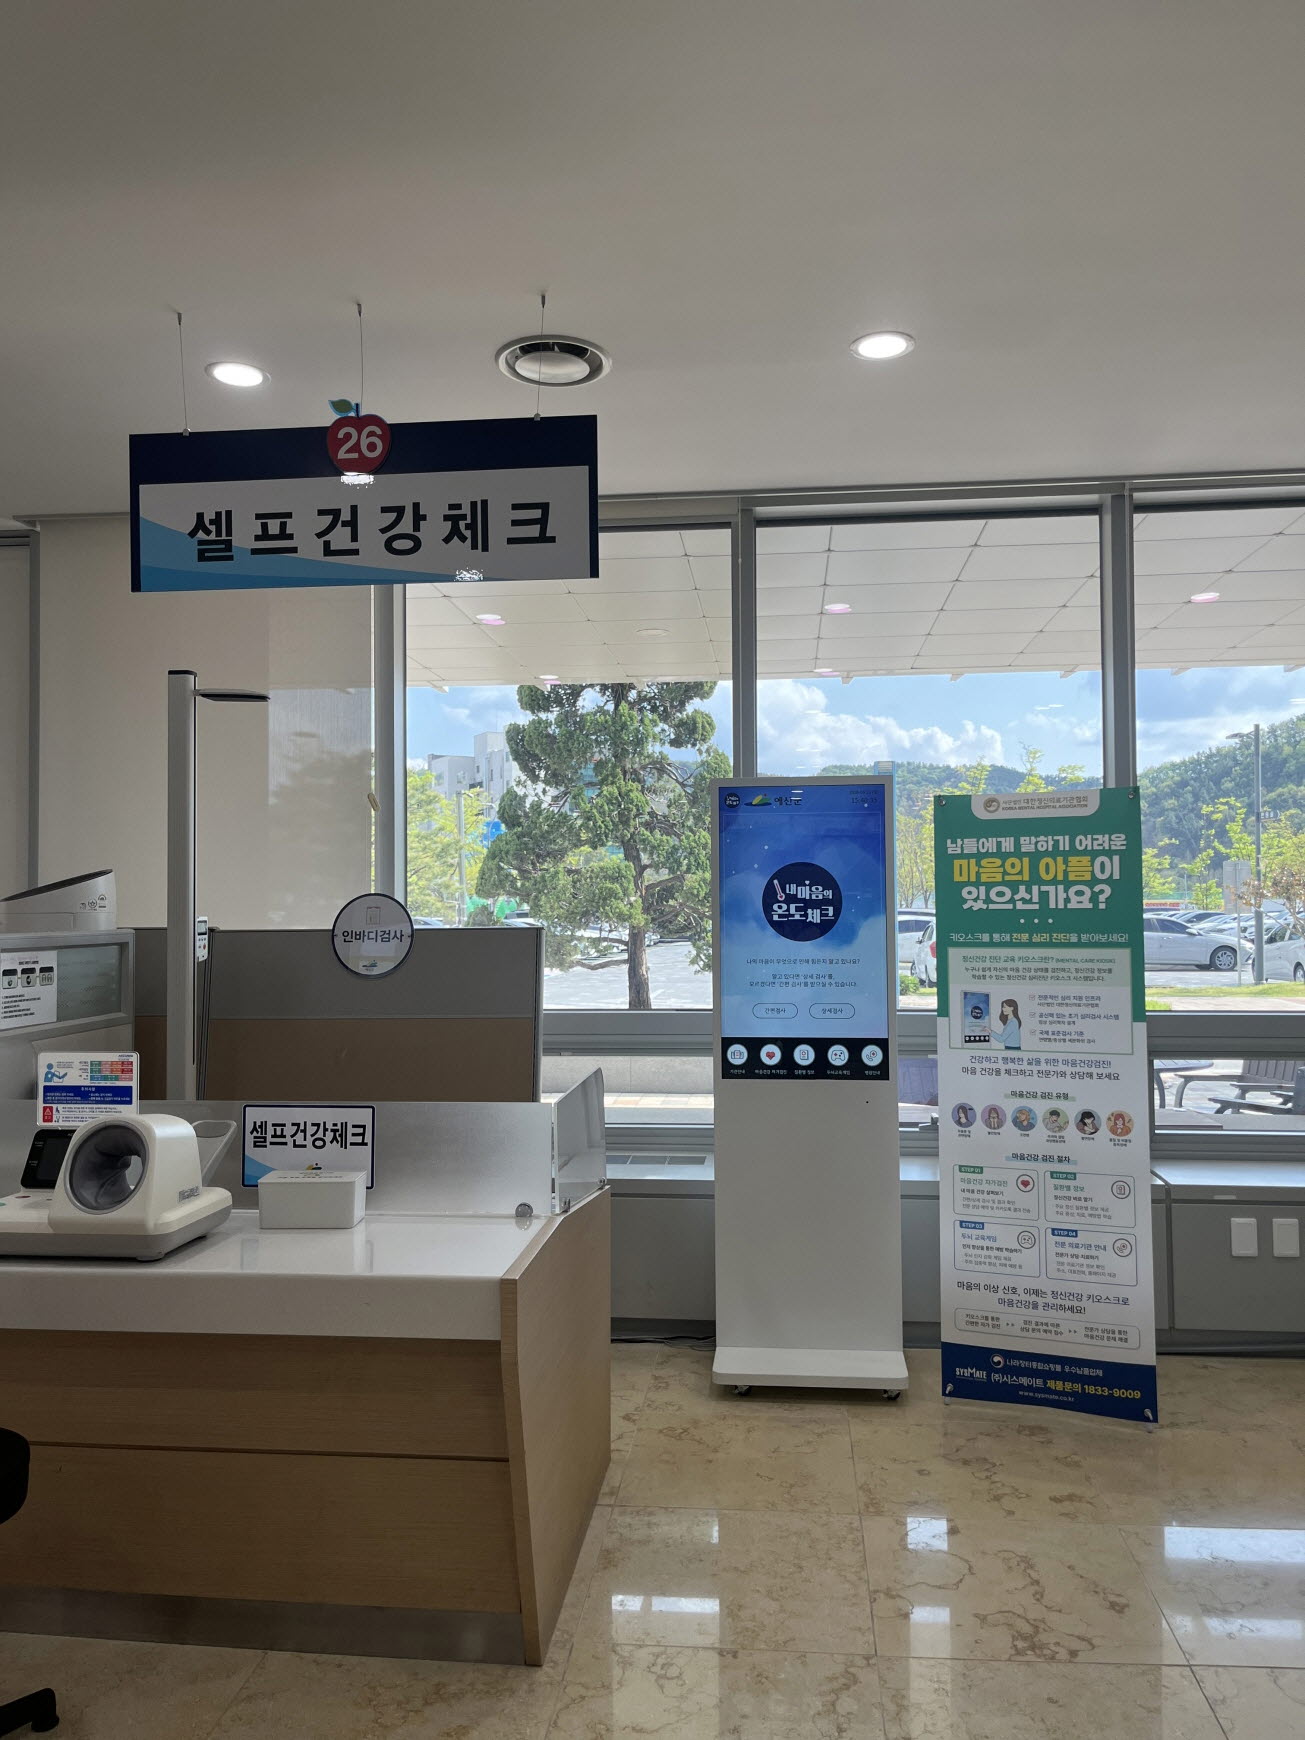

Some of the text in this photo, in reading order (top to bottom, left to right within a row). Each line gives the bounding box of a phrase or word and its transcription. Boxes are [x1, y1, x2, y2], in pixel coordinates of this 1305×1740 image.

[336, 425, 384, 460] 26
[187, 498, 557, 563] 셀프건강체크
[946, 833, 1127, 854] 남들에게 말하기 어려운
[953, 855, 1120, 882] 마음의 아픔이
[961, 883, 1112, 911] 있으신가요?
[772, 902, 835, 924] 온도체크
[342, 930, 404, 943] 인바디검사
[950, 933, 1129, 942] 키오스크를 통해 전문 심리 진단을 받아보세요!
[970, 1056, 1111, 1068] 건강하고 행복한 삶을 위한 마음건강검진!
[962, 1067, 1120, 1080] 마음 건강을 체크하고 전문가와 상담해 보세요
[1010, 1091, 1038, 1099] 마음건강
[250, 1120, 368, 1149] 셀프건강체크
[1012, 1153, 1039, 1161] 마음건강
[957, 1281, 1130, 1306] 마음의 이상 신호, 이제는 정신건강 키오스크로
[998, 1298, 1086, 1314] 마음건강을 관리하세요!
[1006, 1359, 1062, 1372] 나라장터종합쇼핑몰
[991, 1372, 1044, 1387] (주)시스메이트
[1046, 1380, 1081, 1393] 제품문의
[1084, 1384, 1141, 1399] 1833-9009
